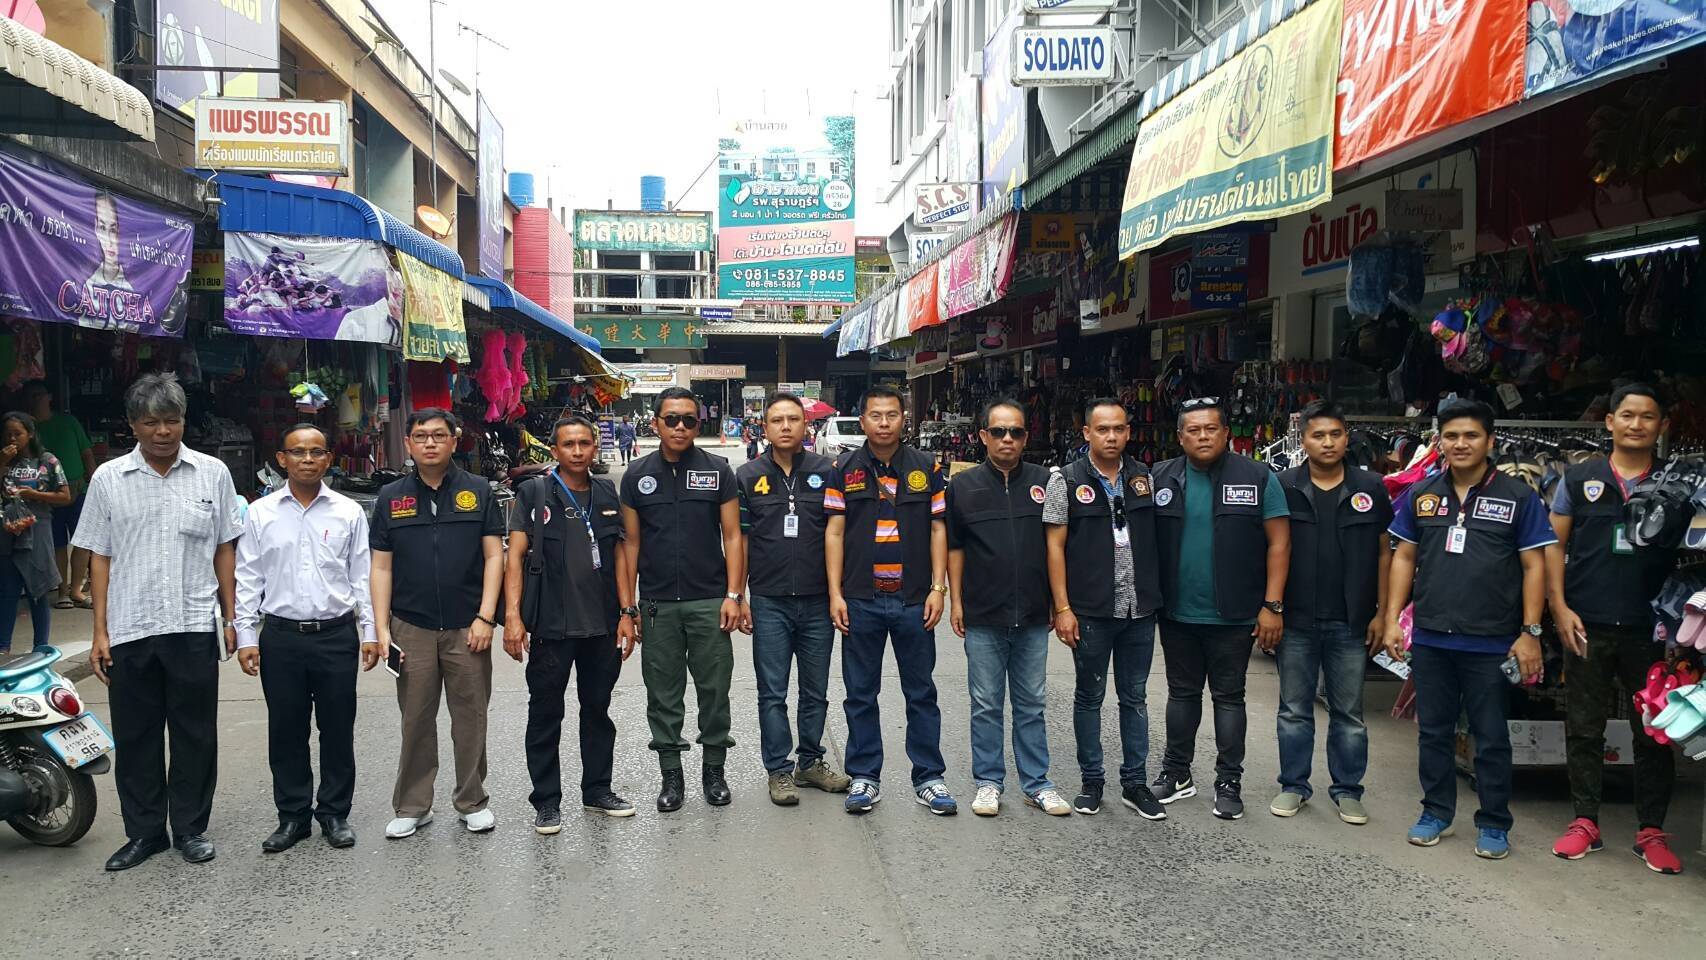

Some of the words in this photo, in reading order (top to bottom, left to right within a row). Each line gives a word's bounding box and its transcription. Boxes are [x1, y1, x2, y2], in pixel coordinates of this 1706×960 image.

[1024, 36, 1104, 71] SOLDATO
[209, 108, 330, 136] แพรพรรณ
[732, 210, 738, 218] 2
[924, 208, 951, 224] PERFECT
[952, 203, 969, 214] STEP
[744, 269, 845, 281] 081-537-8845
[57, 280, 156, 324] CATCHA
[754, 476, 770, 495] 4
[80, 742, 101, 756] 96
